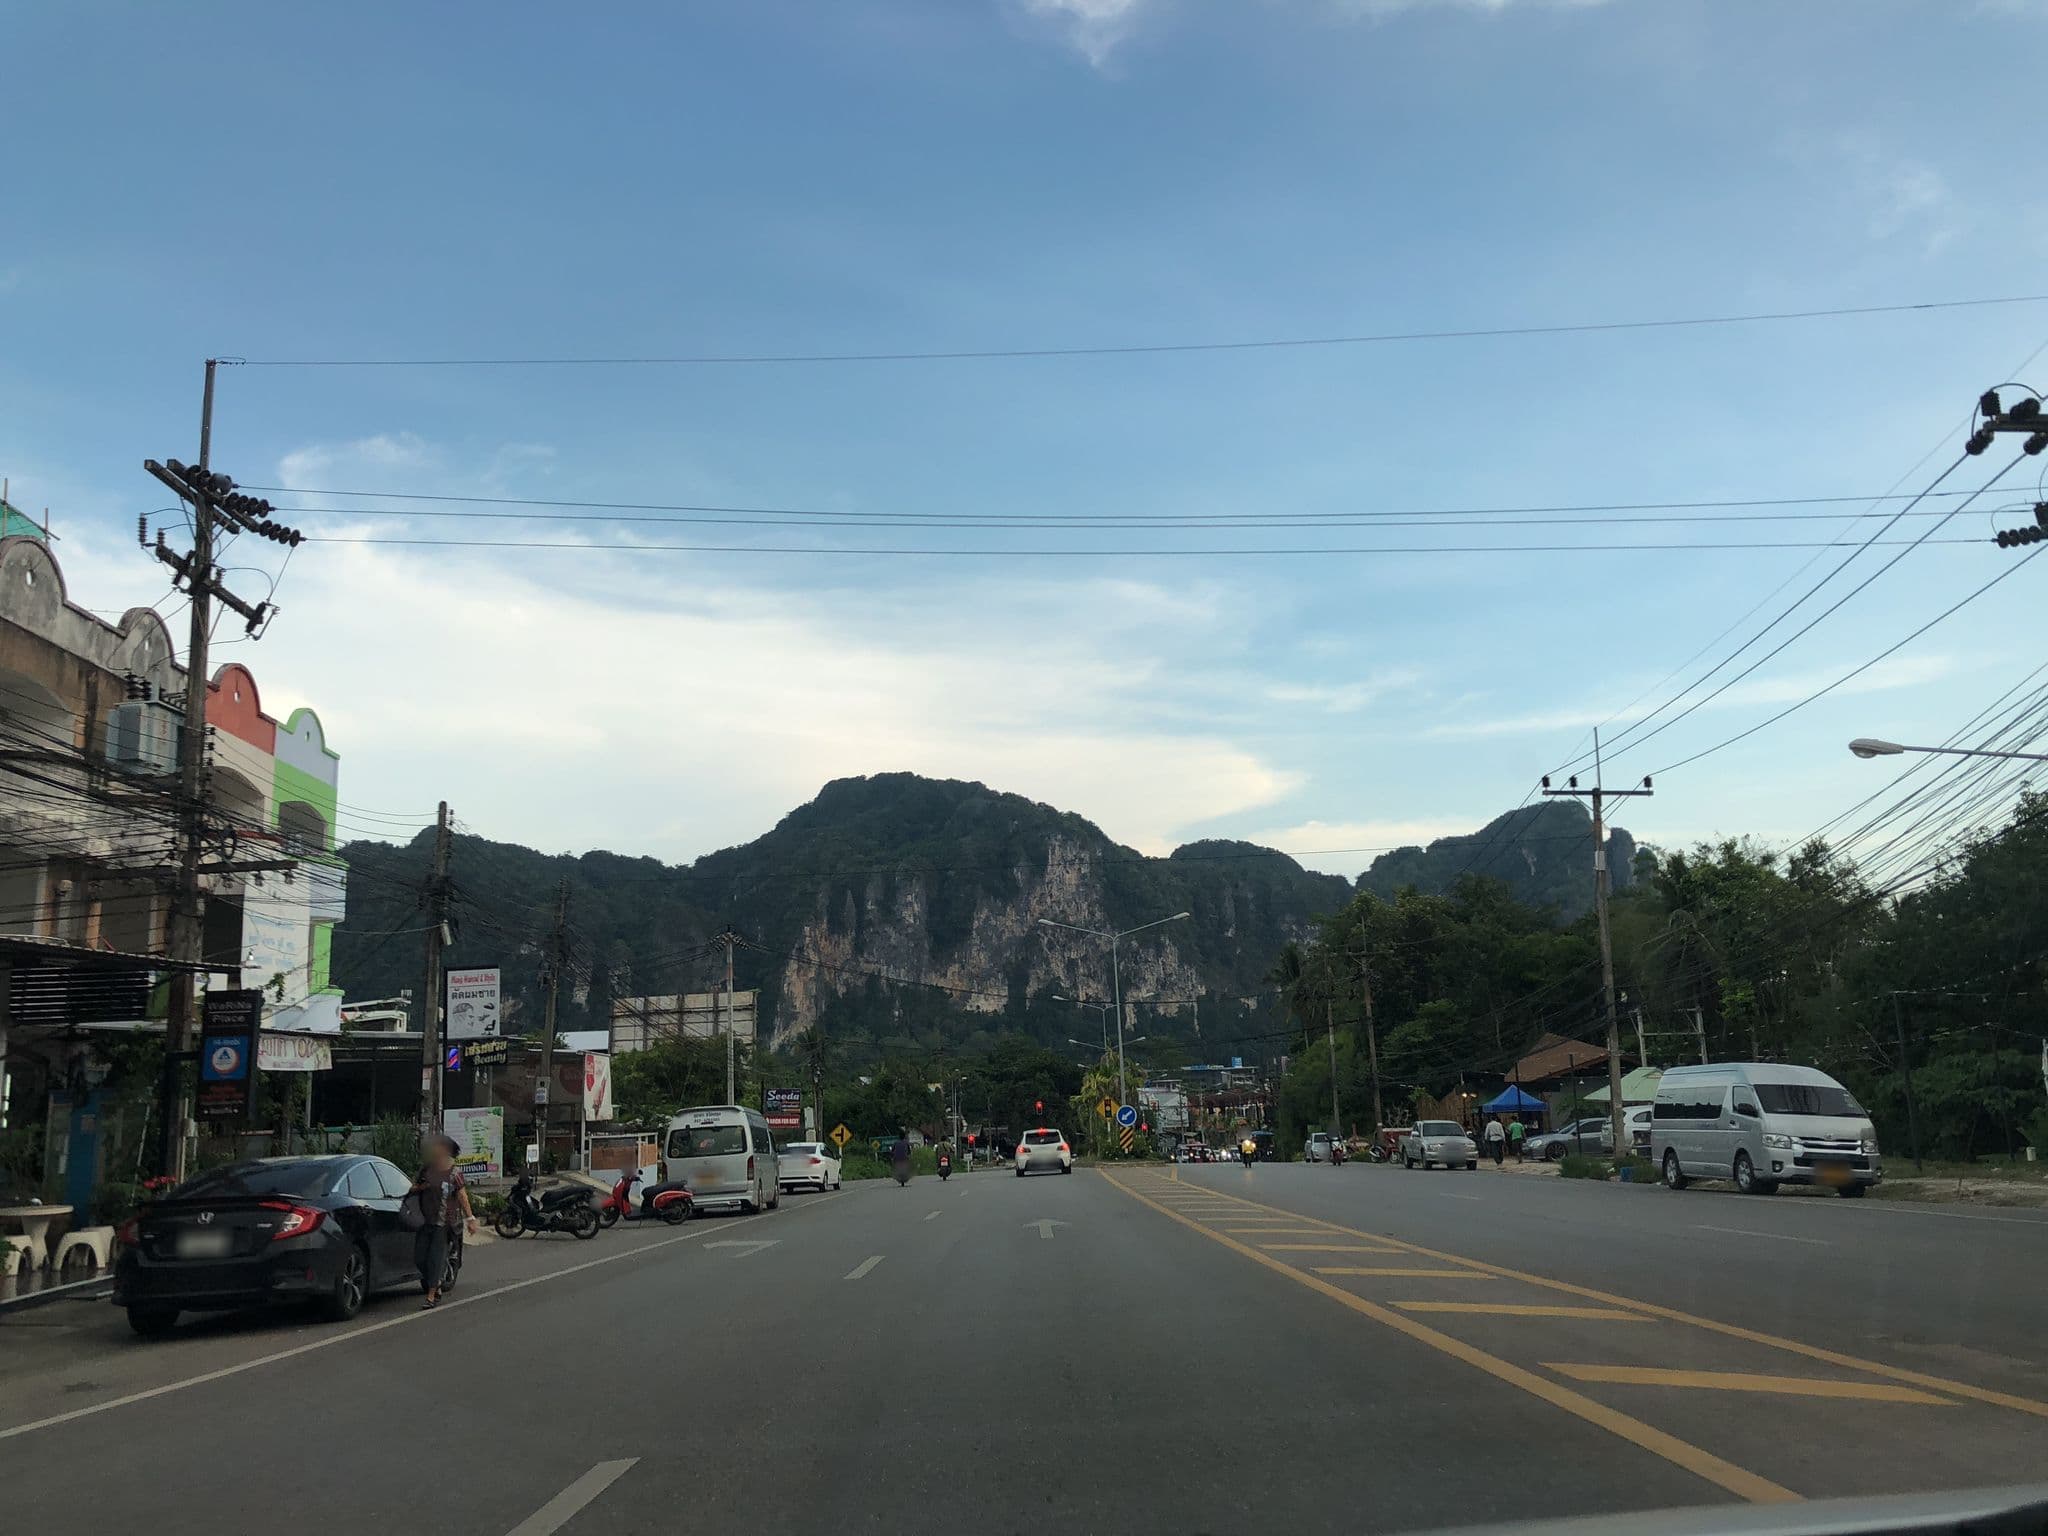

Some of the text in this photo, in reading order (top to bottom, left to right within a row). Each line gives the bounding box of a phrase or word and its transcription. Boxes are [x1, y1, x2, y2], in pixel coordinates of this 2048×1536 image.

[451, 987, 496, 1000] ตัดผมชาย
[212, 1014, 246, 1023] Place
[474, 1053, 507, 1065] Beauty
[767, 1090, 800, 1101] Seeda
